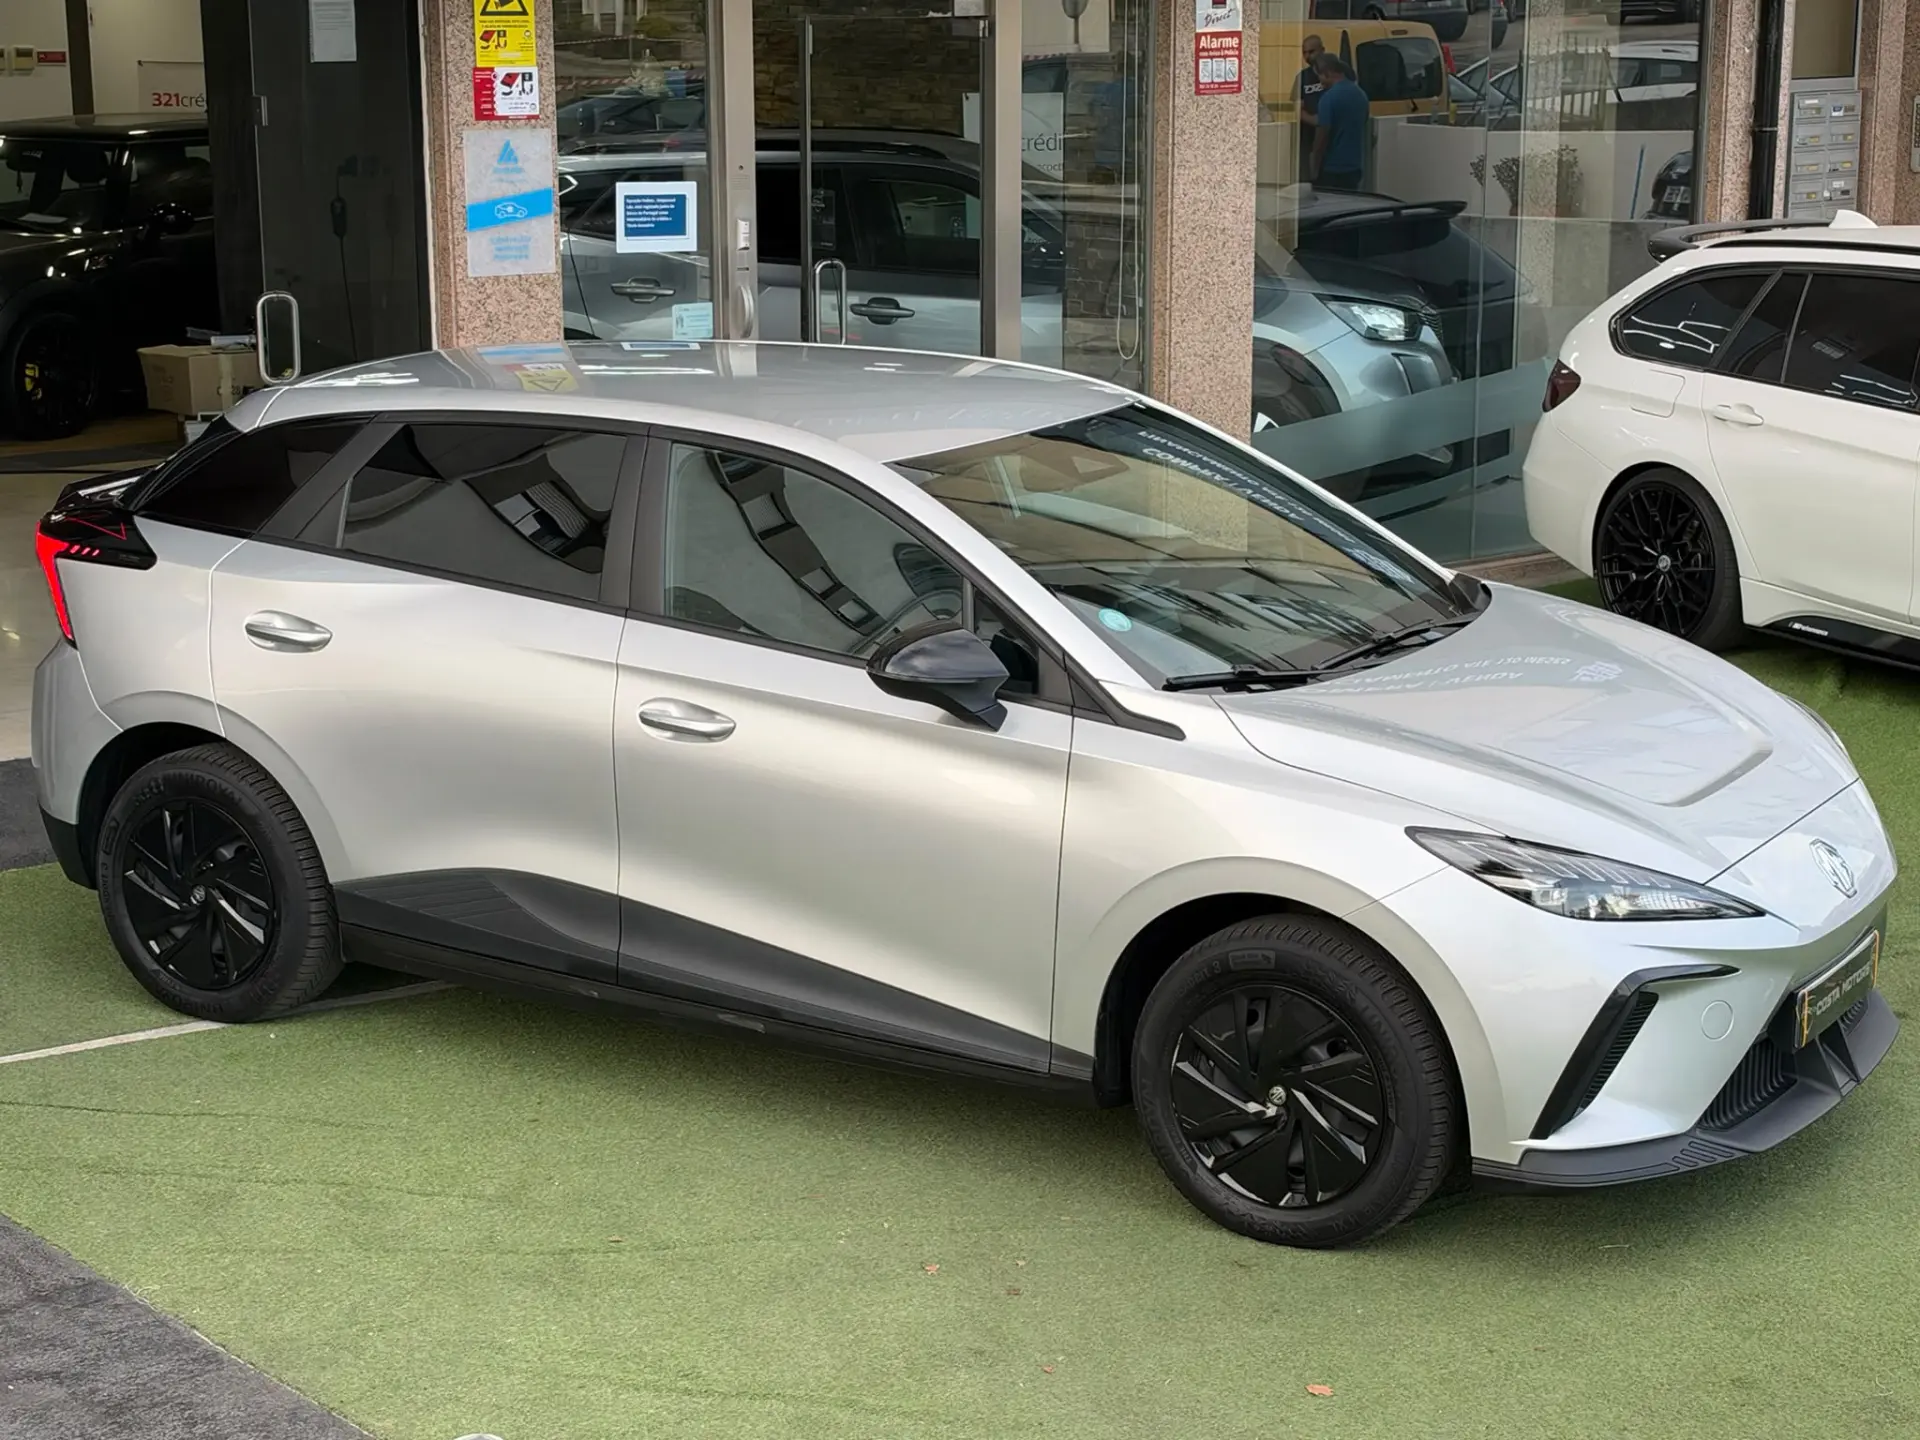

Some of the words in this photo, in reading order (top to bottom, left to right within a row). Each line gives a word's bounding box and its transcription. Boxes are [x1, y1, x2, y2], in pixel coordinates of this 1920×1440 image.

[1199, 35, 1239, 49] Alarme
[152, 93, 208, 108] 321cré
[1816, 988, 1840, 1016] COSTA
[1842, 964, 1871, 995] MOTORS
